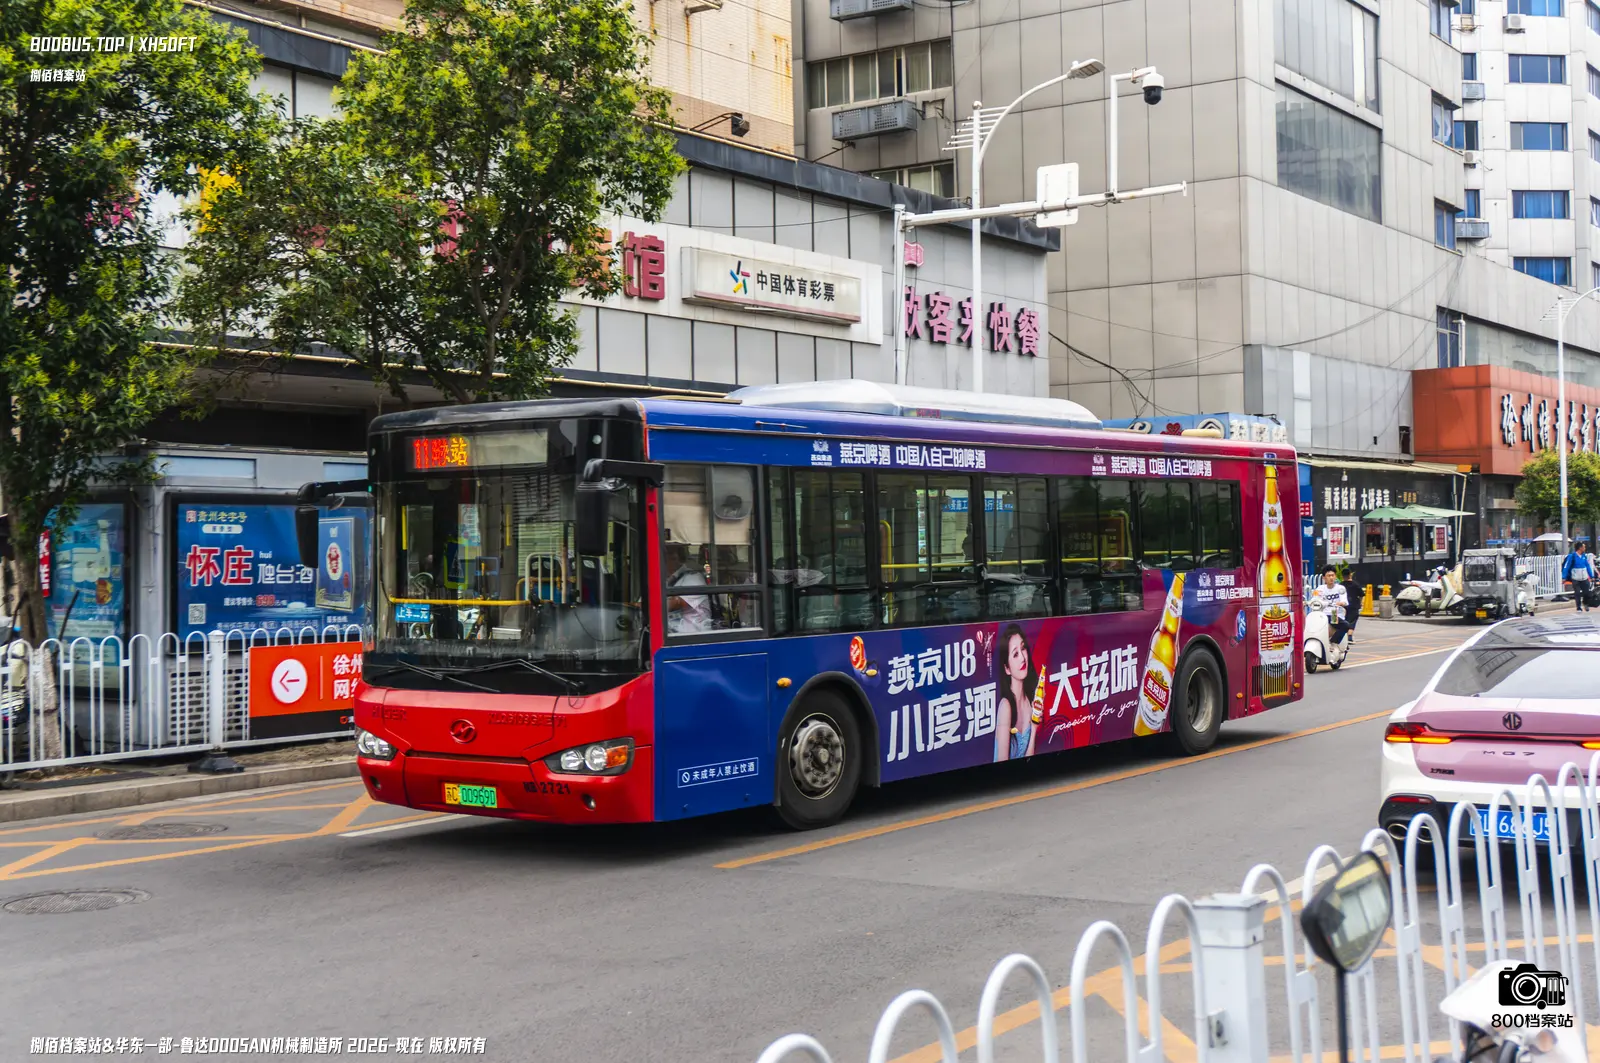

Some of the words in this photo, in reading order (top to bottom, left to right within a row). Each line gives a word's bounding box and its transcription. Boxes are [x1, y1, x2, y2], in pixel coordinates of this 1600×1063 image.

[756, 269, 835, 302] 中国体育彩票
[839, 443, 891, 465] 燕京啤酒
[895, 445, 986, 469] 中国人自己的啤酒
[1111, 456, 1146, 475] 燕京啤酒
[1149, 458, 1213, 477] 中国人自己的啤酒
[186, 543, 255, 587] 怀庄
[887, 638, 977, 695] 燕京U8
[1049, 643, 1138, 717] 大滋味
[886, 681, 997, 763] 小度酒
[1048, 712, 1096, 744] passion
[1095, 703, 1116, 725] for
[1117, 698, 1139, 718] you
[1503, 712, 1522, 730] MG
[692, 761, 755, 781] 未成年人禁止饮酒
